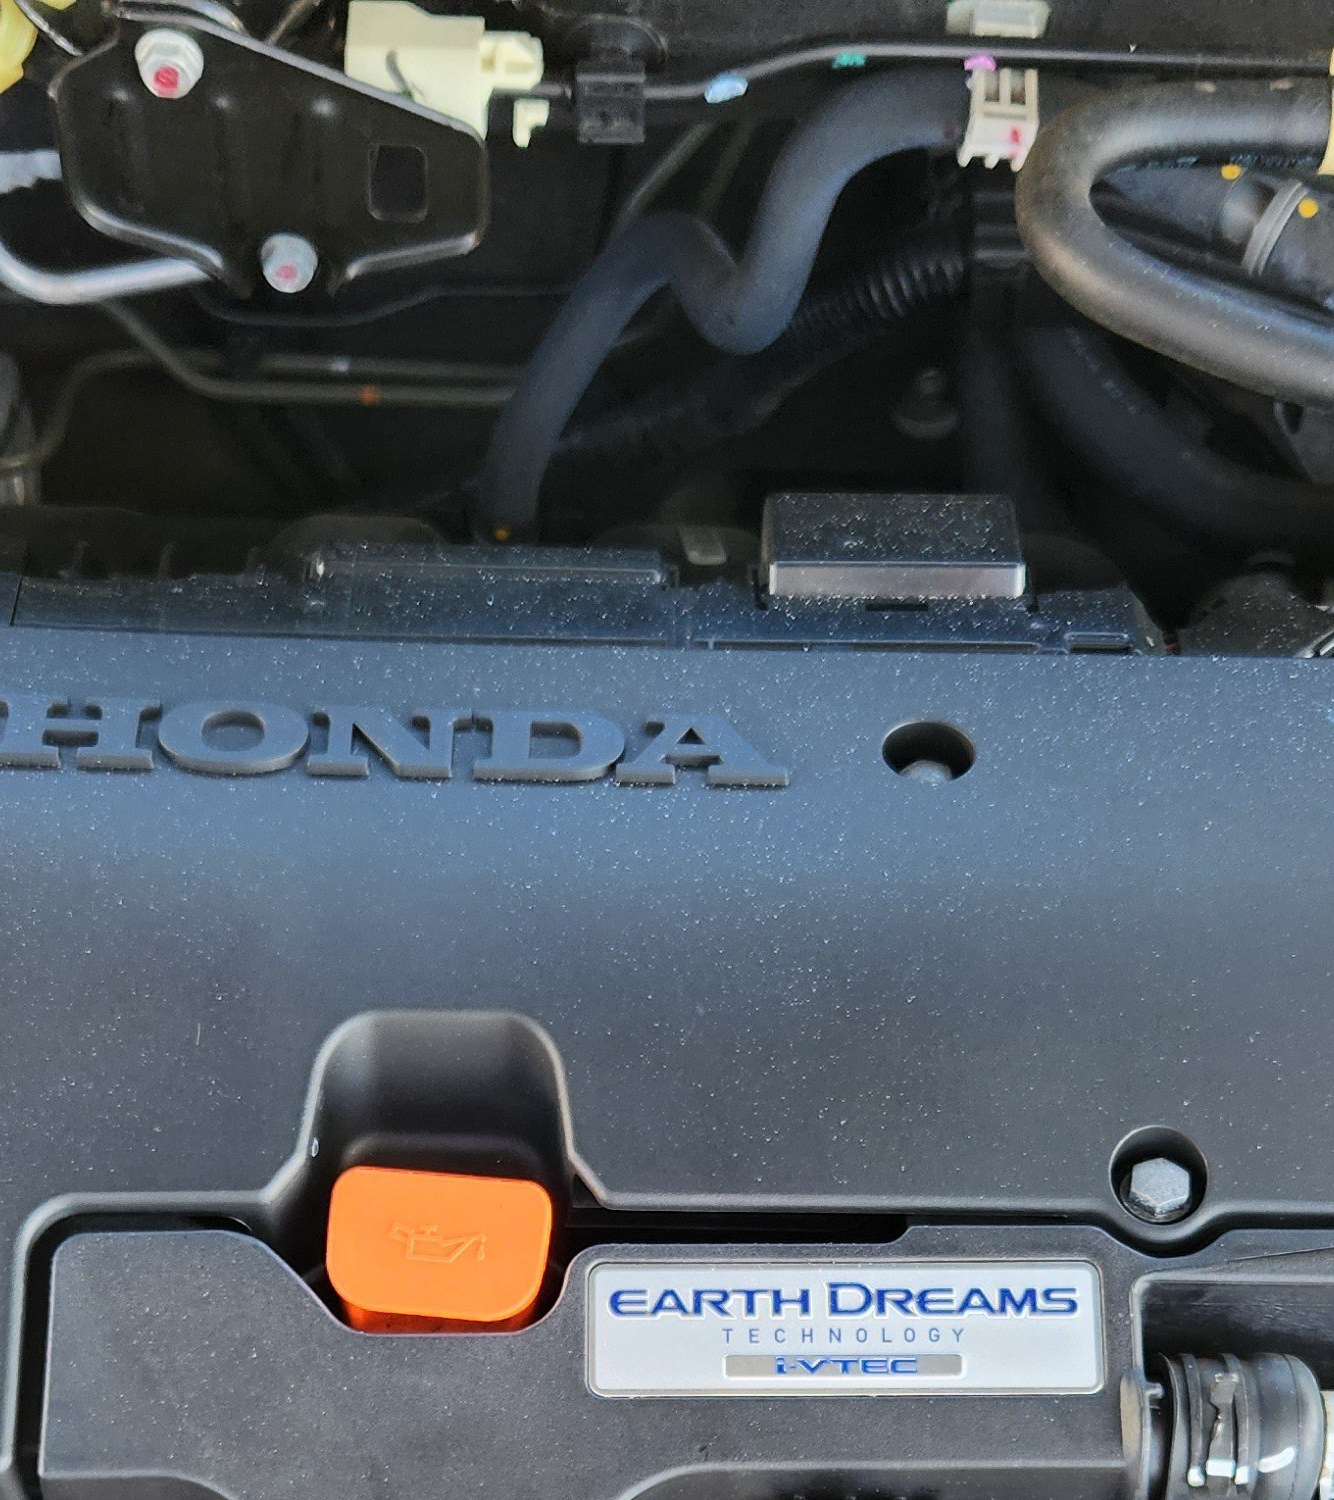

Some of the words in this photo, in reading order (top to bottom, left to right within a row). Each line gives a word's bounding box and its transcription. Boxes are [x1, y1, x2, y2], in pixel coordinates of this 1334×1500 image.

[608, 1287, 812, 1319] EARTH
[826, 1280, 1079, 1319] DREAMS
[721, 1327, 966, 1344] TECHNOLOGY
